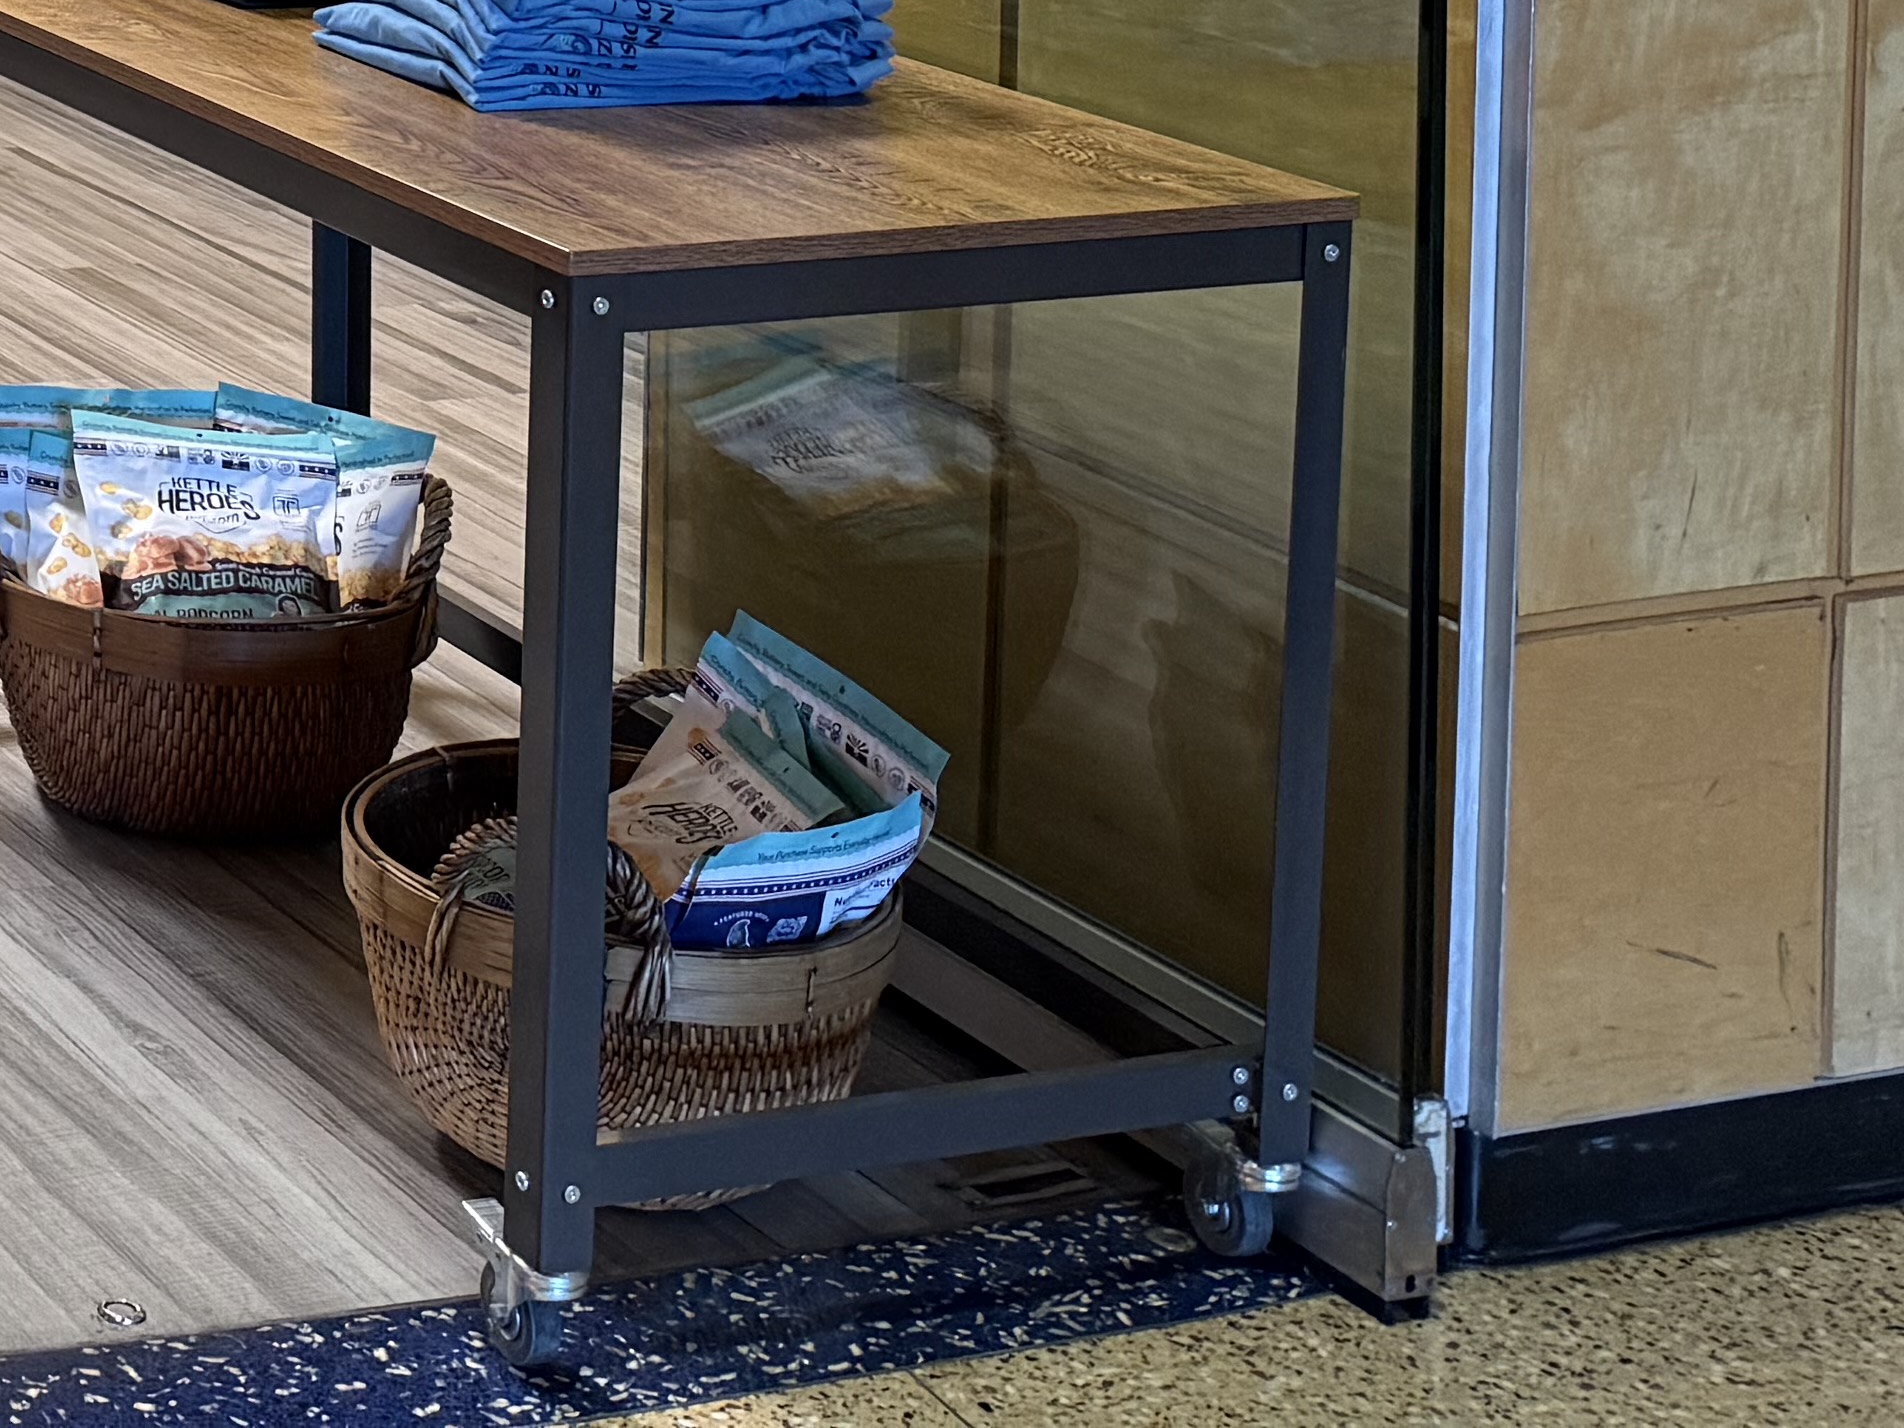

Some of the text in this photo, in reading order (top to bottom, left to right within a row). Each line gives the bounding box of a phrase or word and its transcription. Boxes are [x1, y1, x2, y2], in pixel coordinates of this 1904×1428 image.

[171, 477, 238, 495] KETTLE
[158, 489, 261, 520] HEROES
[131, 571, 315, 601] SEA SALTED CARAMEL
[700, 802, 740, 838] KETTLE
